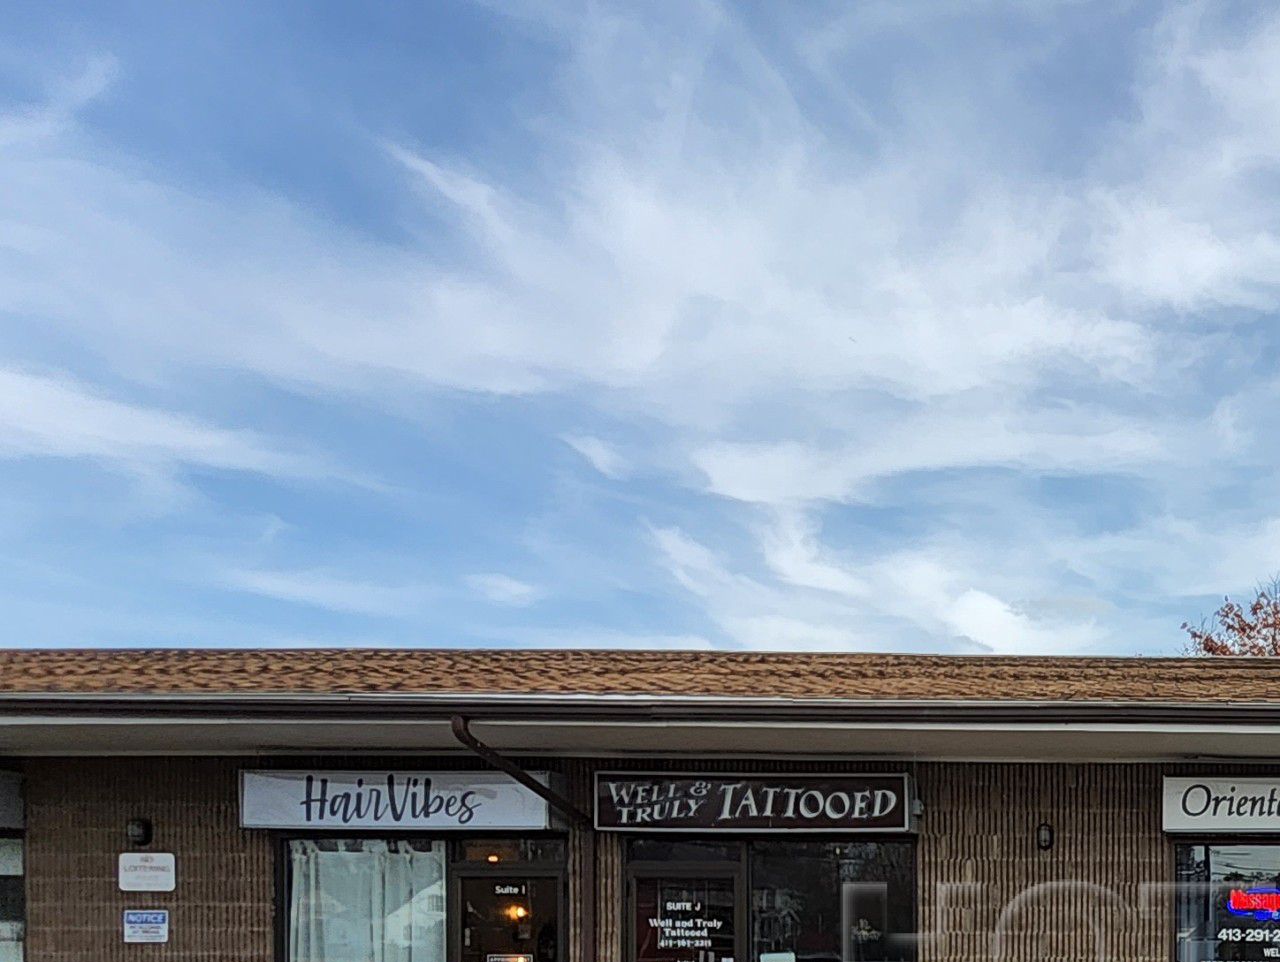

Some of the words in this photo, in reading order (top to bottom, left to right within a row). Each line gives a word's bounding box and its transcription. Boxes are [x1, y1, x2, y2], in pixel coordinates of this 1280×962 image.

[689, 780, 711, 796] &
[616, 799, 704, 824] TRULY
[495, 885, 520, 894] Suite
[666, 902, 692, 911] SUITE
[695, 902, 701, 911] J
[649, 918, 672, 928] Well
[675, 918, 694, 928] and
[696, 918, 723, 929] Truly
